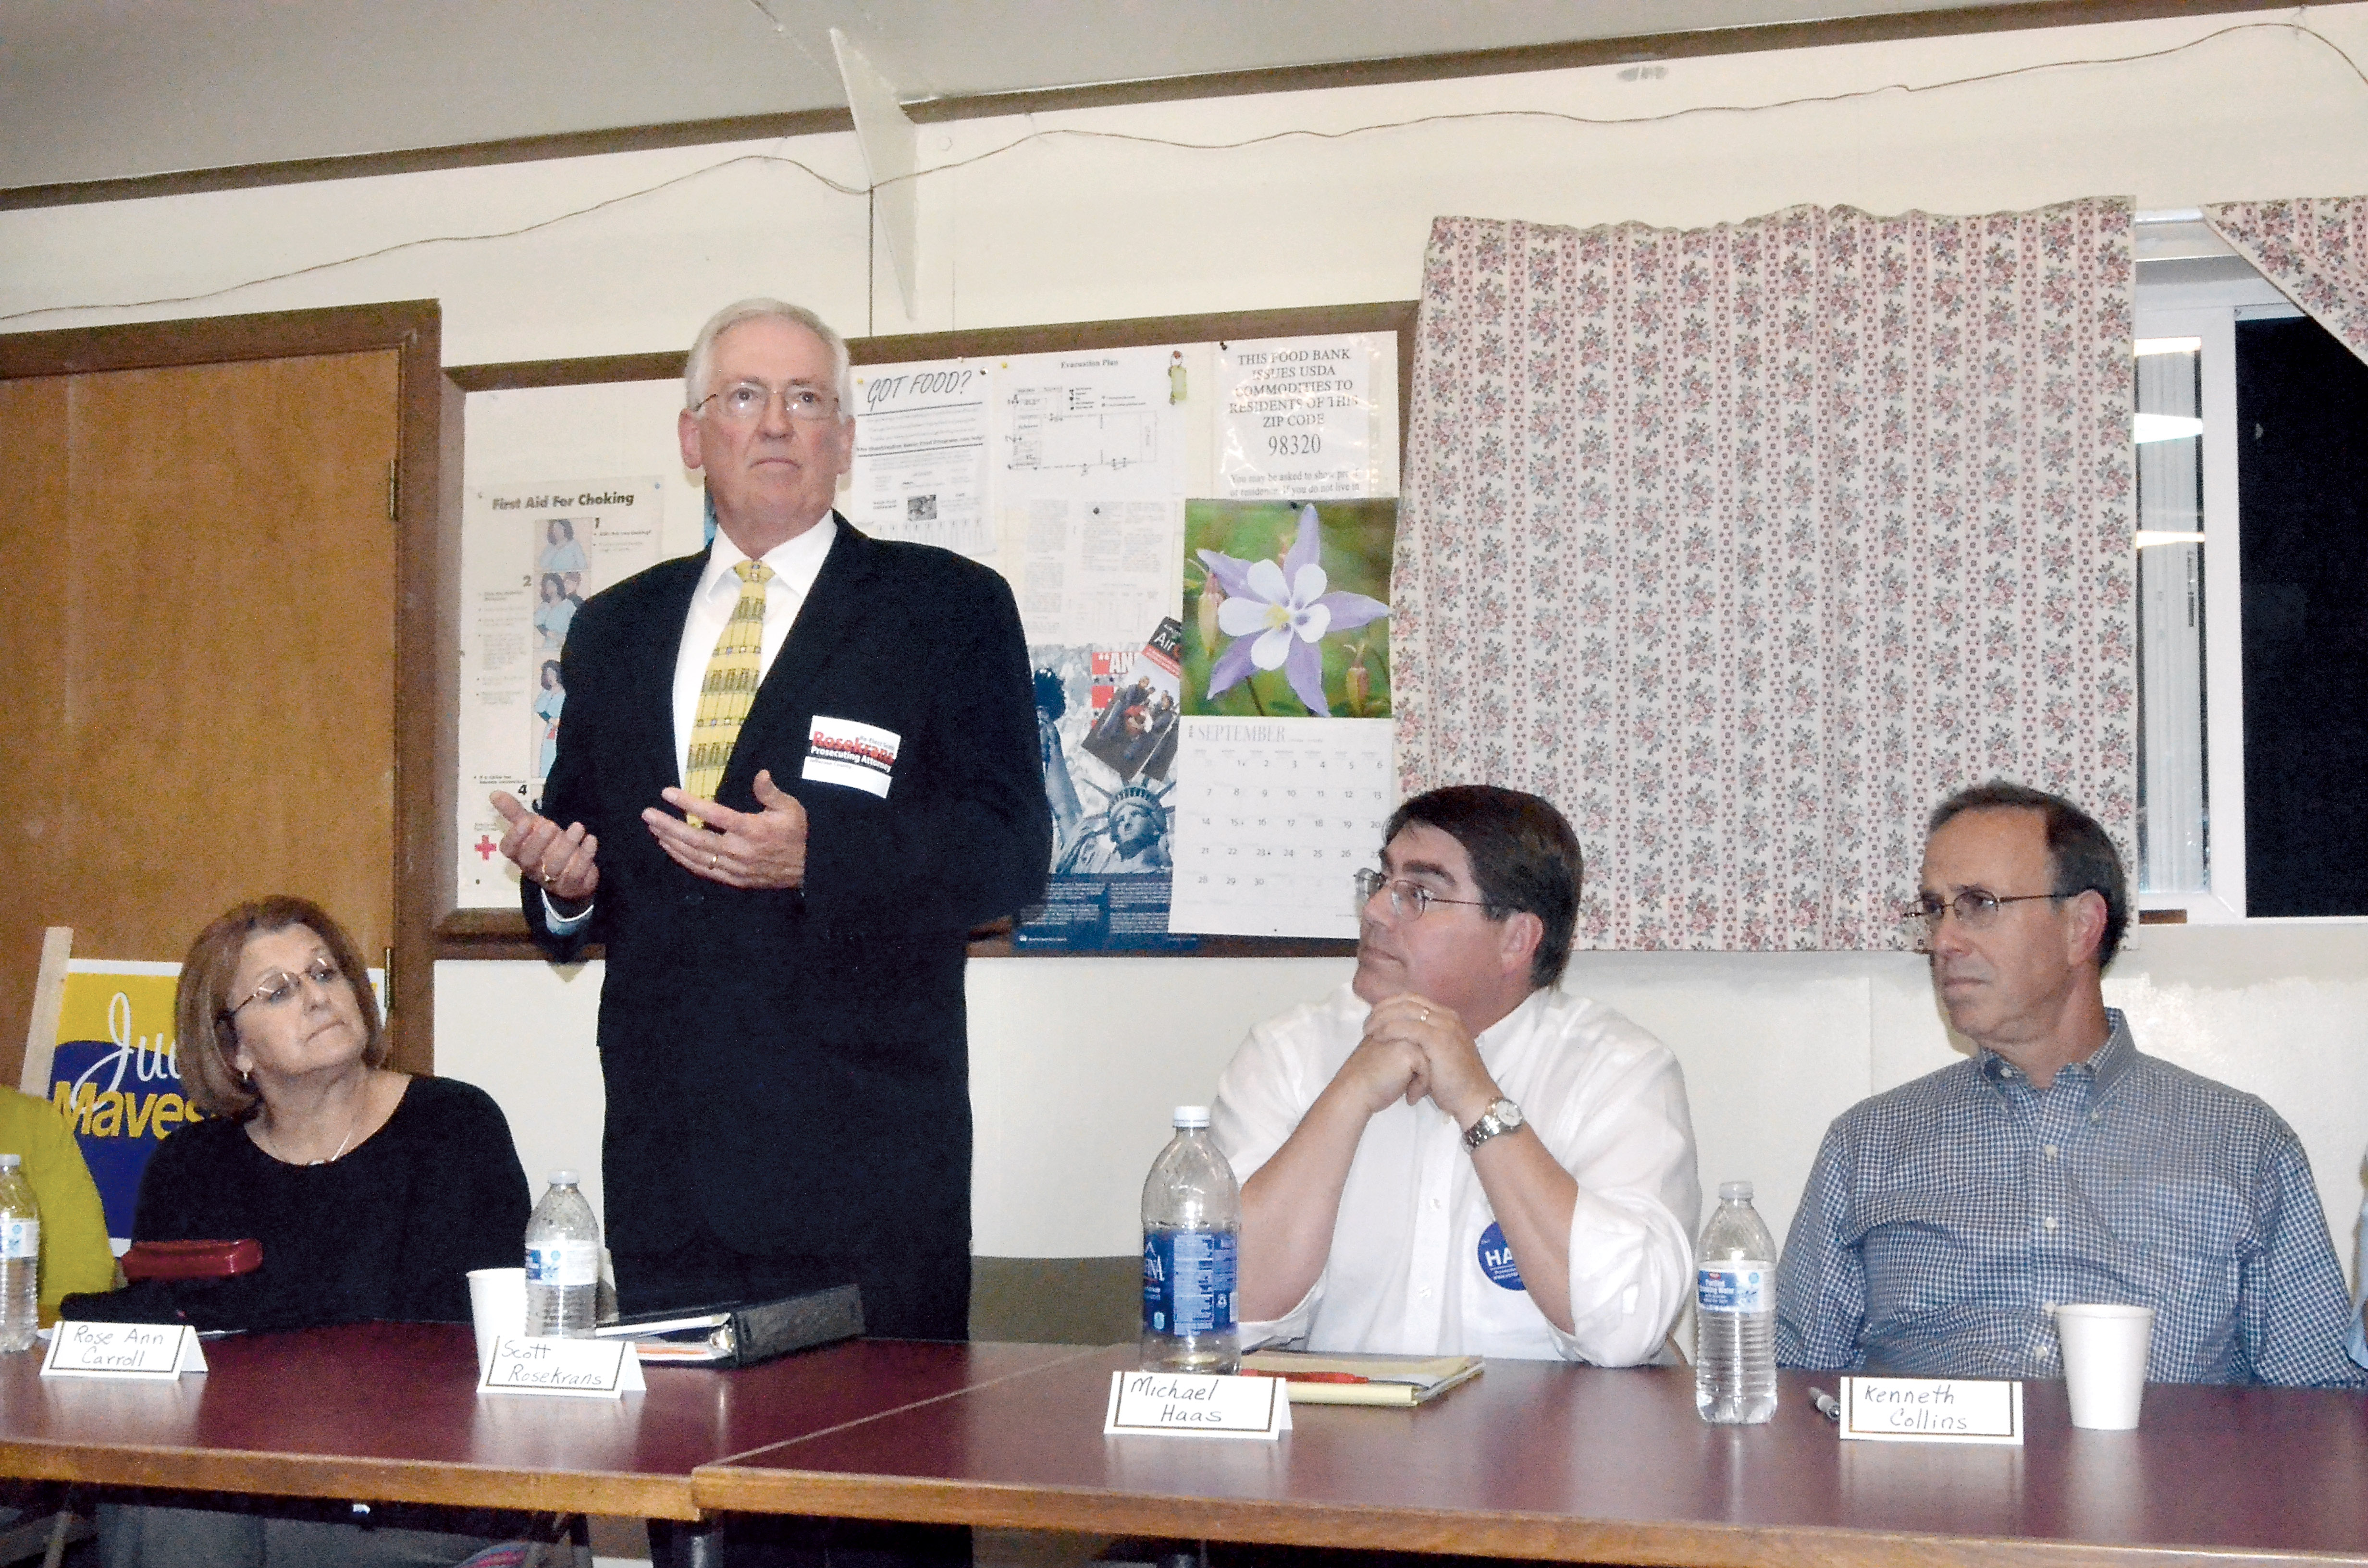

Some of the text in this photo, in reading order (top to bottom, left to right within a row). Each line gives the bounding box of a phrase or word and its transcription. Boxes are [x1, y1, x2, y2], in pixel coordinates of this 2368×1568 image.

[1103, 358, 1118, 367] Plan
[1237, 349, 1351, 366] THIS FOOD BANK
[1252, 367, 1335, 380] ISSUES USDA
[867, 370, 973, 411] GOT FOOD?
[1235, 380, 1353, 398] COMMODITIES TO
[1229, 399, 1303, 414] RESIDENTS
[1307, 398, 1323, 409] OF
[1263, 414, 1325, 429] ZIP CODE
[1269, 434, 1321, 456] 98320
[493, 491, 634, 511] First Aid For Choking
[594, 517, 600, 529] 1
[523, 576, 531, 587] 2
[1198, 724, 1285, 742] SEPTEMBER
[812, 731, 895, 766] Rosekrans
[811, 746, 891, 773] Prosecuting Attorney
[518, 784, 527, 796] 4
[1287, 789, 1296, 797] 10
[1344, 820, 1352, 828] 19
[1228, 847, 1237, 856] 22
[1283, 849, 1294, 857] 24
[1313, 850, 1322, 858] 25
[1341, 850, 1352, 858] 26
[1198, 876, 1208, 884] 28
[74, 1324, 163, 1346] Rose Ann
[81, 1346, 145, 1367] Carroll
[501, 1340, 551, 1360] Scott
[1131, 1376, 1220, 1401] Michael
[1864, 1384, 1954, 1405] Kenneth
[1160, 1407, 1222, 1424] Haas
[1890, 1408, 1967, 1430] Collins
